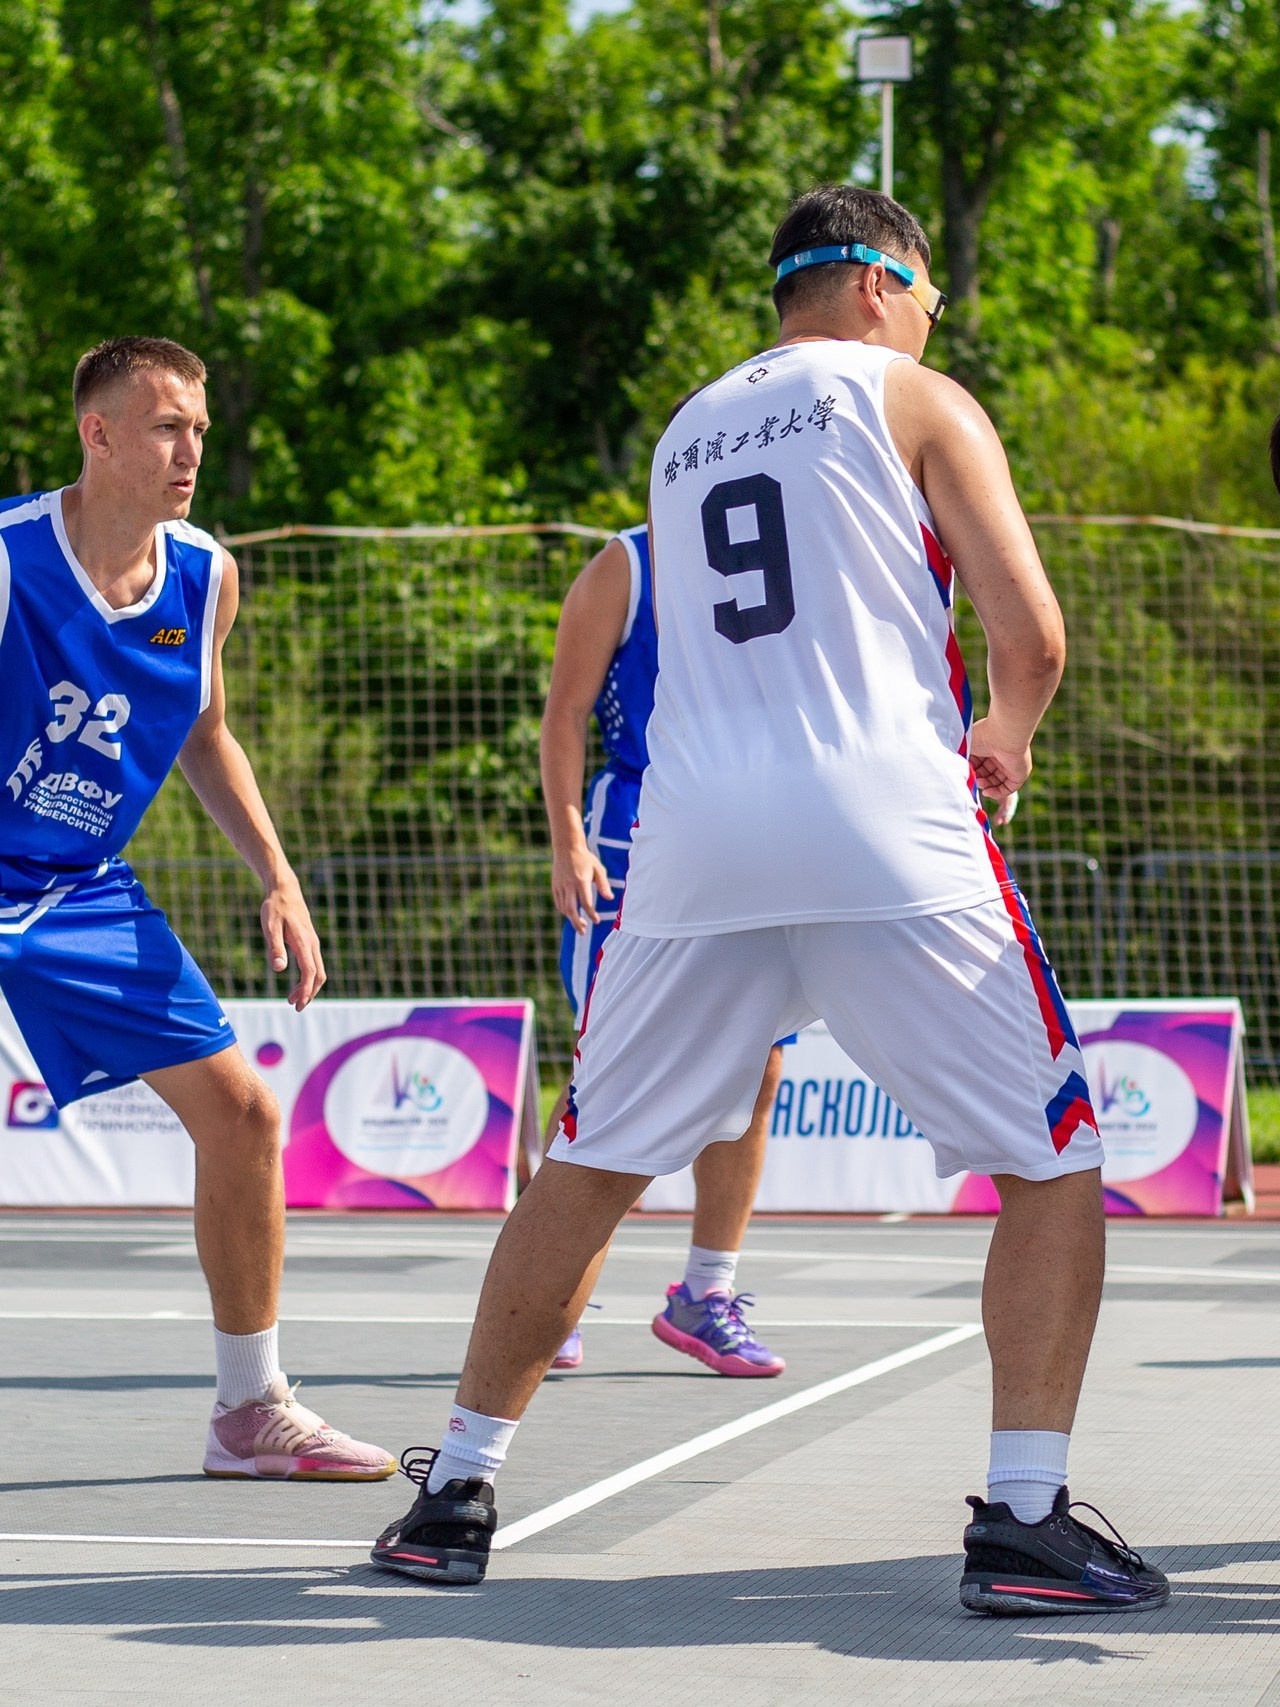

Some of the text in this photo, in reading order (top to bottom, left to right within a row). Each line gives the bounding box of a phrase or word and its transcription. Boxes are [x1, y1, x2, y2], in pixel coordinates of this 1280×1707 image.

[700, 472, 796, 645] 9
[45, 680, 131, 761] 32
[28, 792, 109, 829] ФЕДЕРАЛЬНЫЙ
[38, 772, 123, 809] ДВФУ
[23, 799, 106, 838] УНИВЕРСИТЕТ
[771, 1078, 927, 1138] АСКОЛЬ
